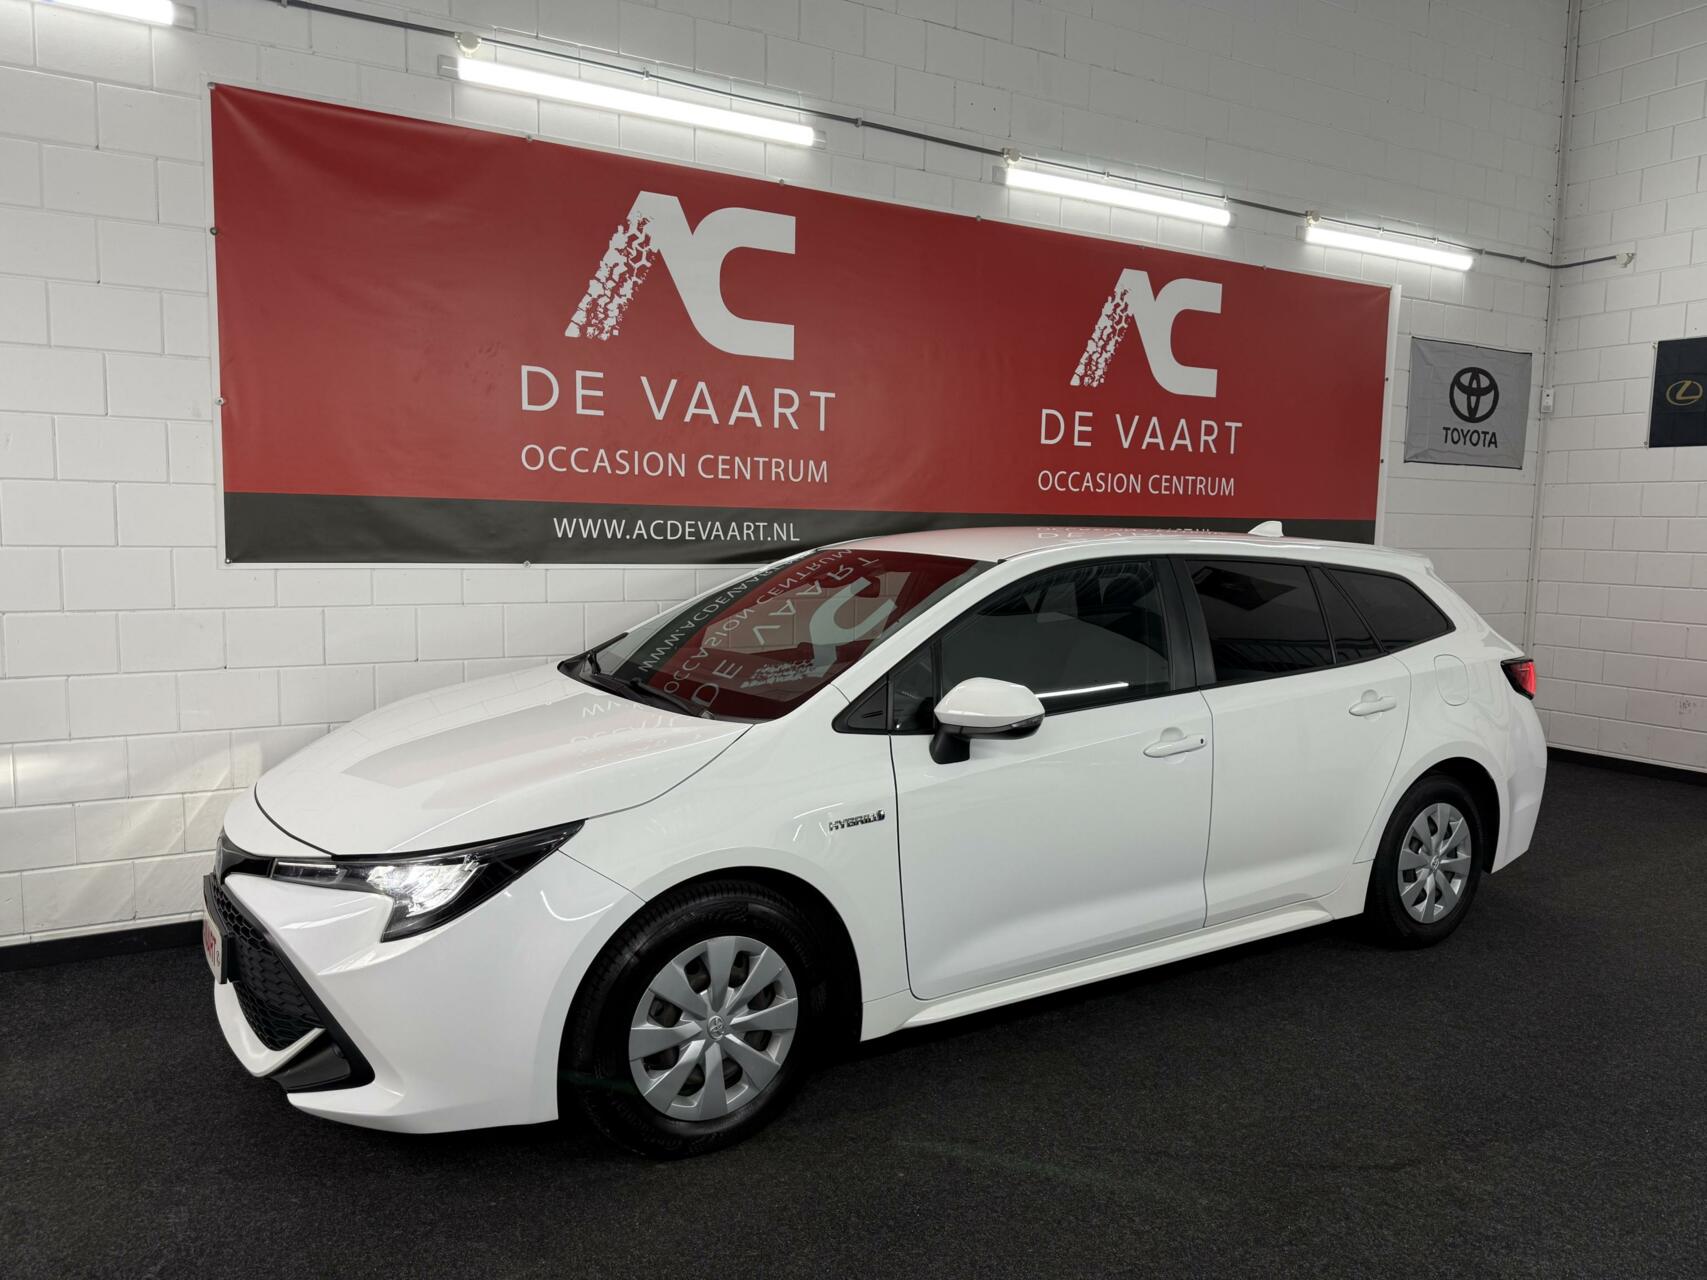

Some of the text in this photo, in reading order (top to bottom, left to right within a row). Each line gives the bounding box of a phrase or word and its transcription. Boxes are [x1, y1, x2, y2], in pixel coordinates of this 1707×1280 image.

[564, 190, 796, 361] AC
[1070, 268, 1223, 398] AC
[520, 364, 836, 432] DE VAART
[1040, 408, 1243, 454] DE VAART
[1442, 426, 1499, 449] TOYOTA
[521, 444, 829, 483] OCCASION CENTRUM
[1038, 470, 1235, 496] OCCASION CENTRUM
[553, 517, 801, 542] WWW.ACDEVAART.NL
